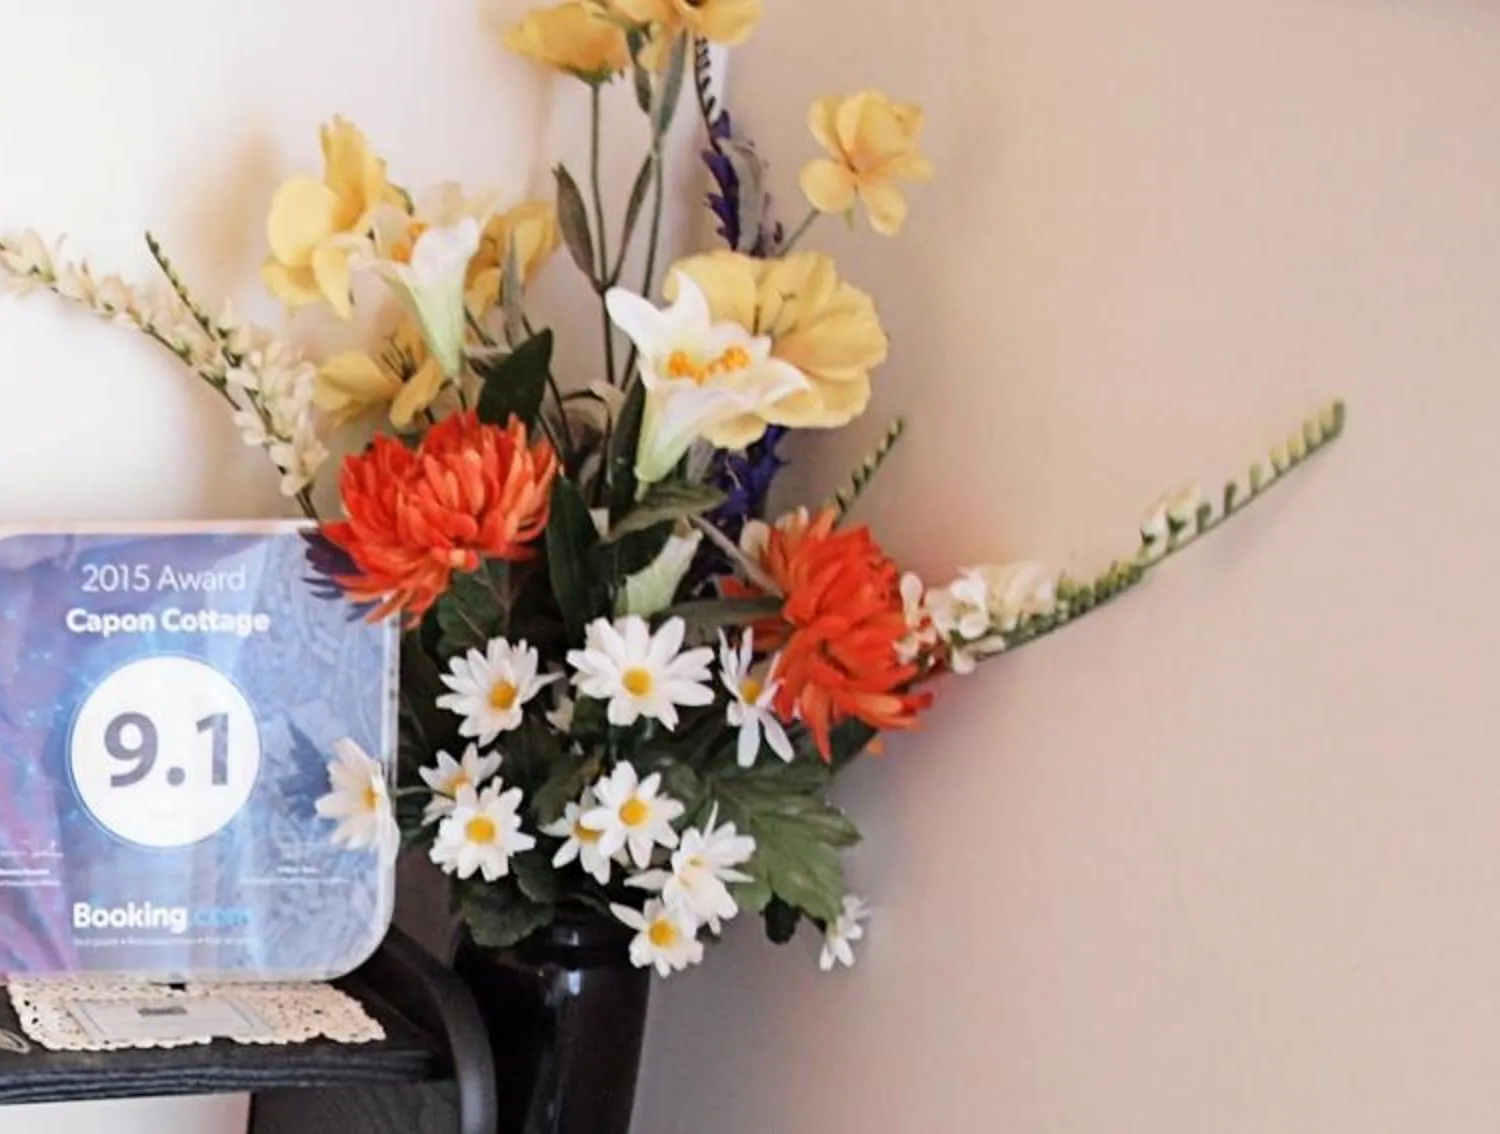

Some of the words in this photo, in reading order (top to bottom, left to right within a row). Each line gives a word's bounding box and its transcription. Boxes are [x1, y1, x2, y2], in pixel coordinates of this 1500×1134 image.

[80, 564, 151, 593] 2015
[157, 563, 246, 592] Award
[66, 608, 156, 637] Capon
[162, 607, 270, 636] Cottage
[103, 711, 230, 788] 9.1
[73, 901, 249, 933] Bookingcom
